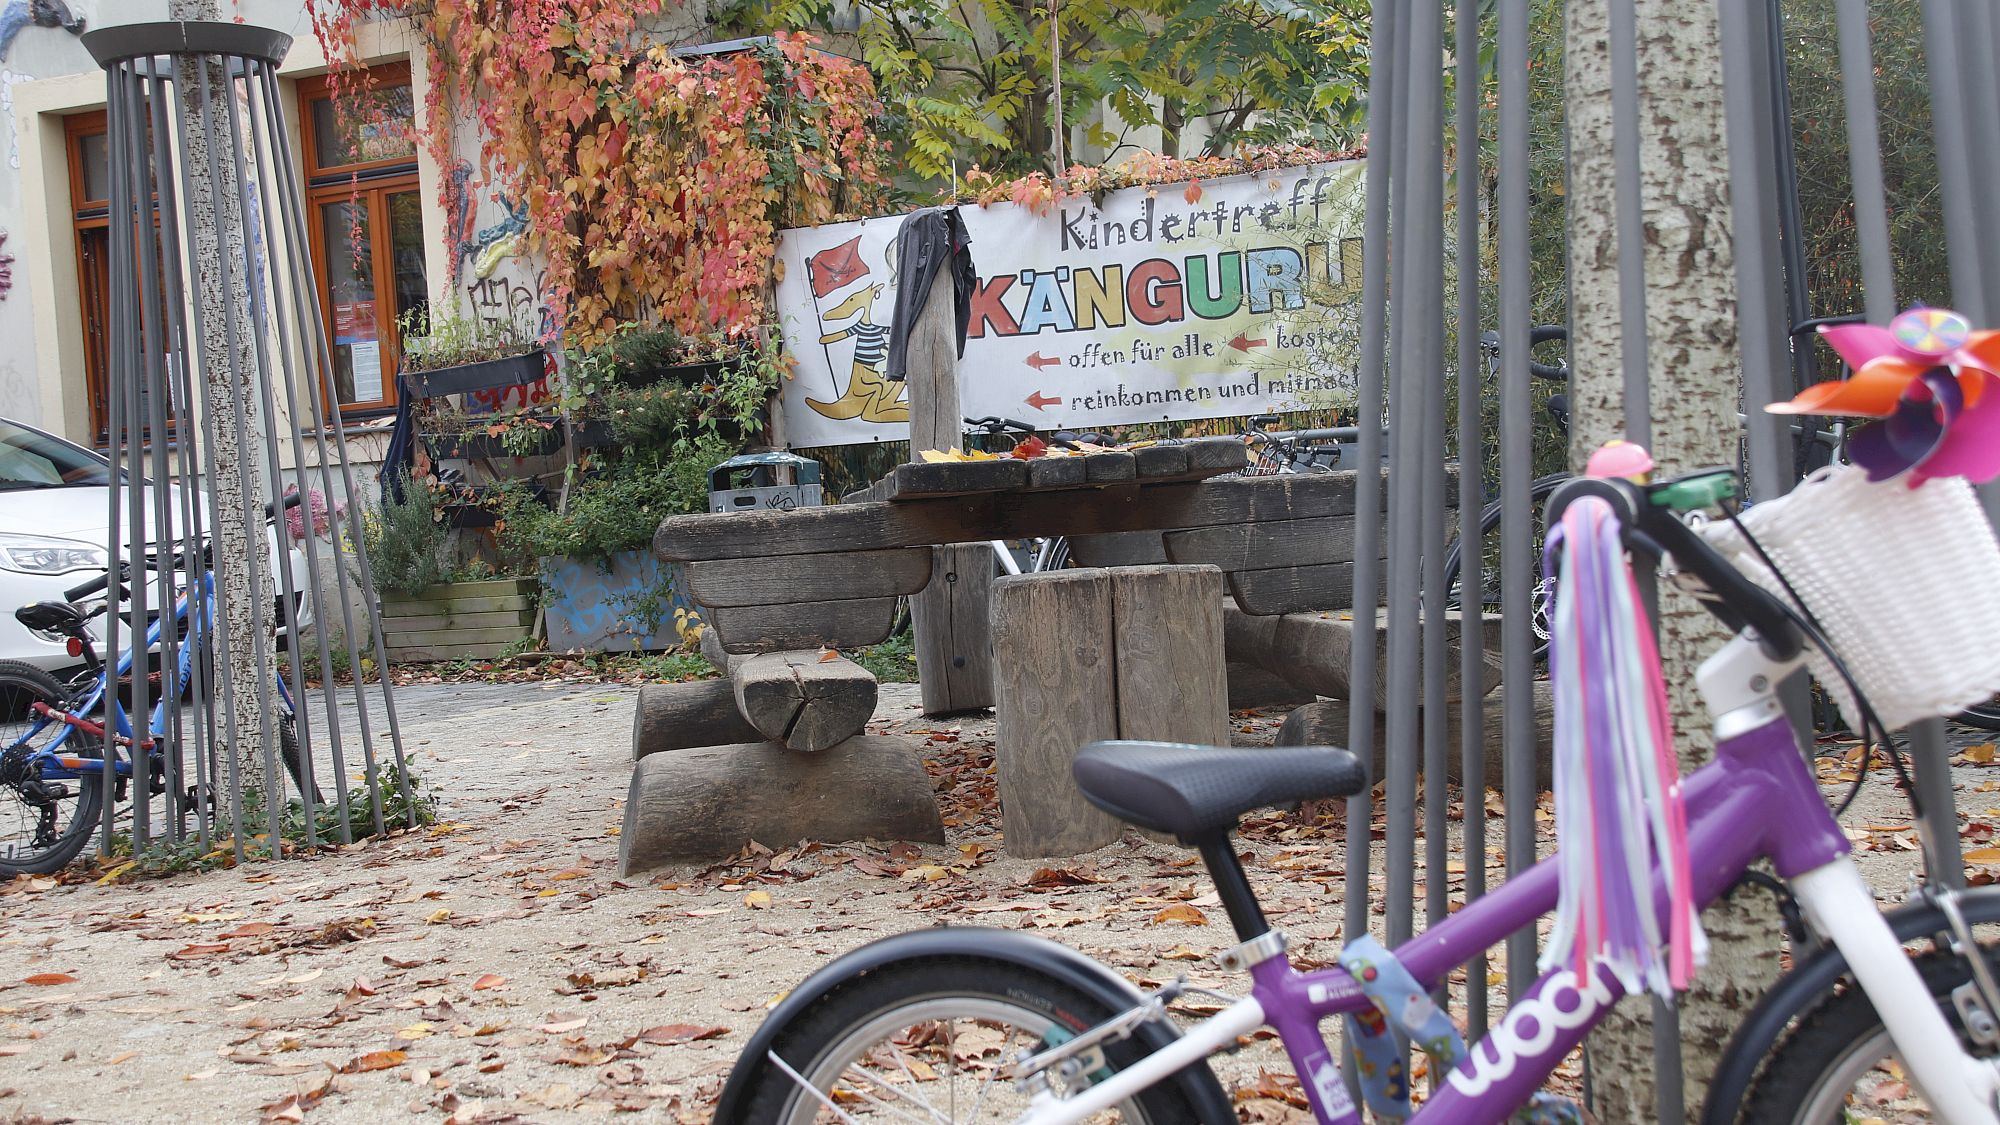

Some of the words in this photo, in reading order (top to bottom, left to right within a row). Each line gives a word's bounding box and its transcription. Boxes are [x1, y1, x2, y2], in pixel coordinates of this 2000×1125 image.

[1060, 177, 1331, 251] Kindertreff
[967, 236, 1364, 339] KÄNGURU
[1069, 343, 1126, 369] offen
[1131, 339, 1166, 364] für
[1172, 333, 1215, 359] alle
[1276, 324, 1358, 349] koste
[1071, 383, 1212, 411] reinkommen
[1218, 372, 1260, 398] und
